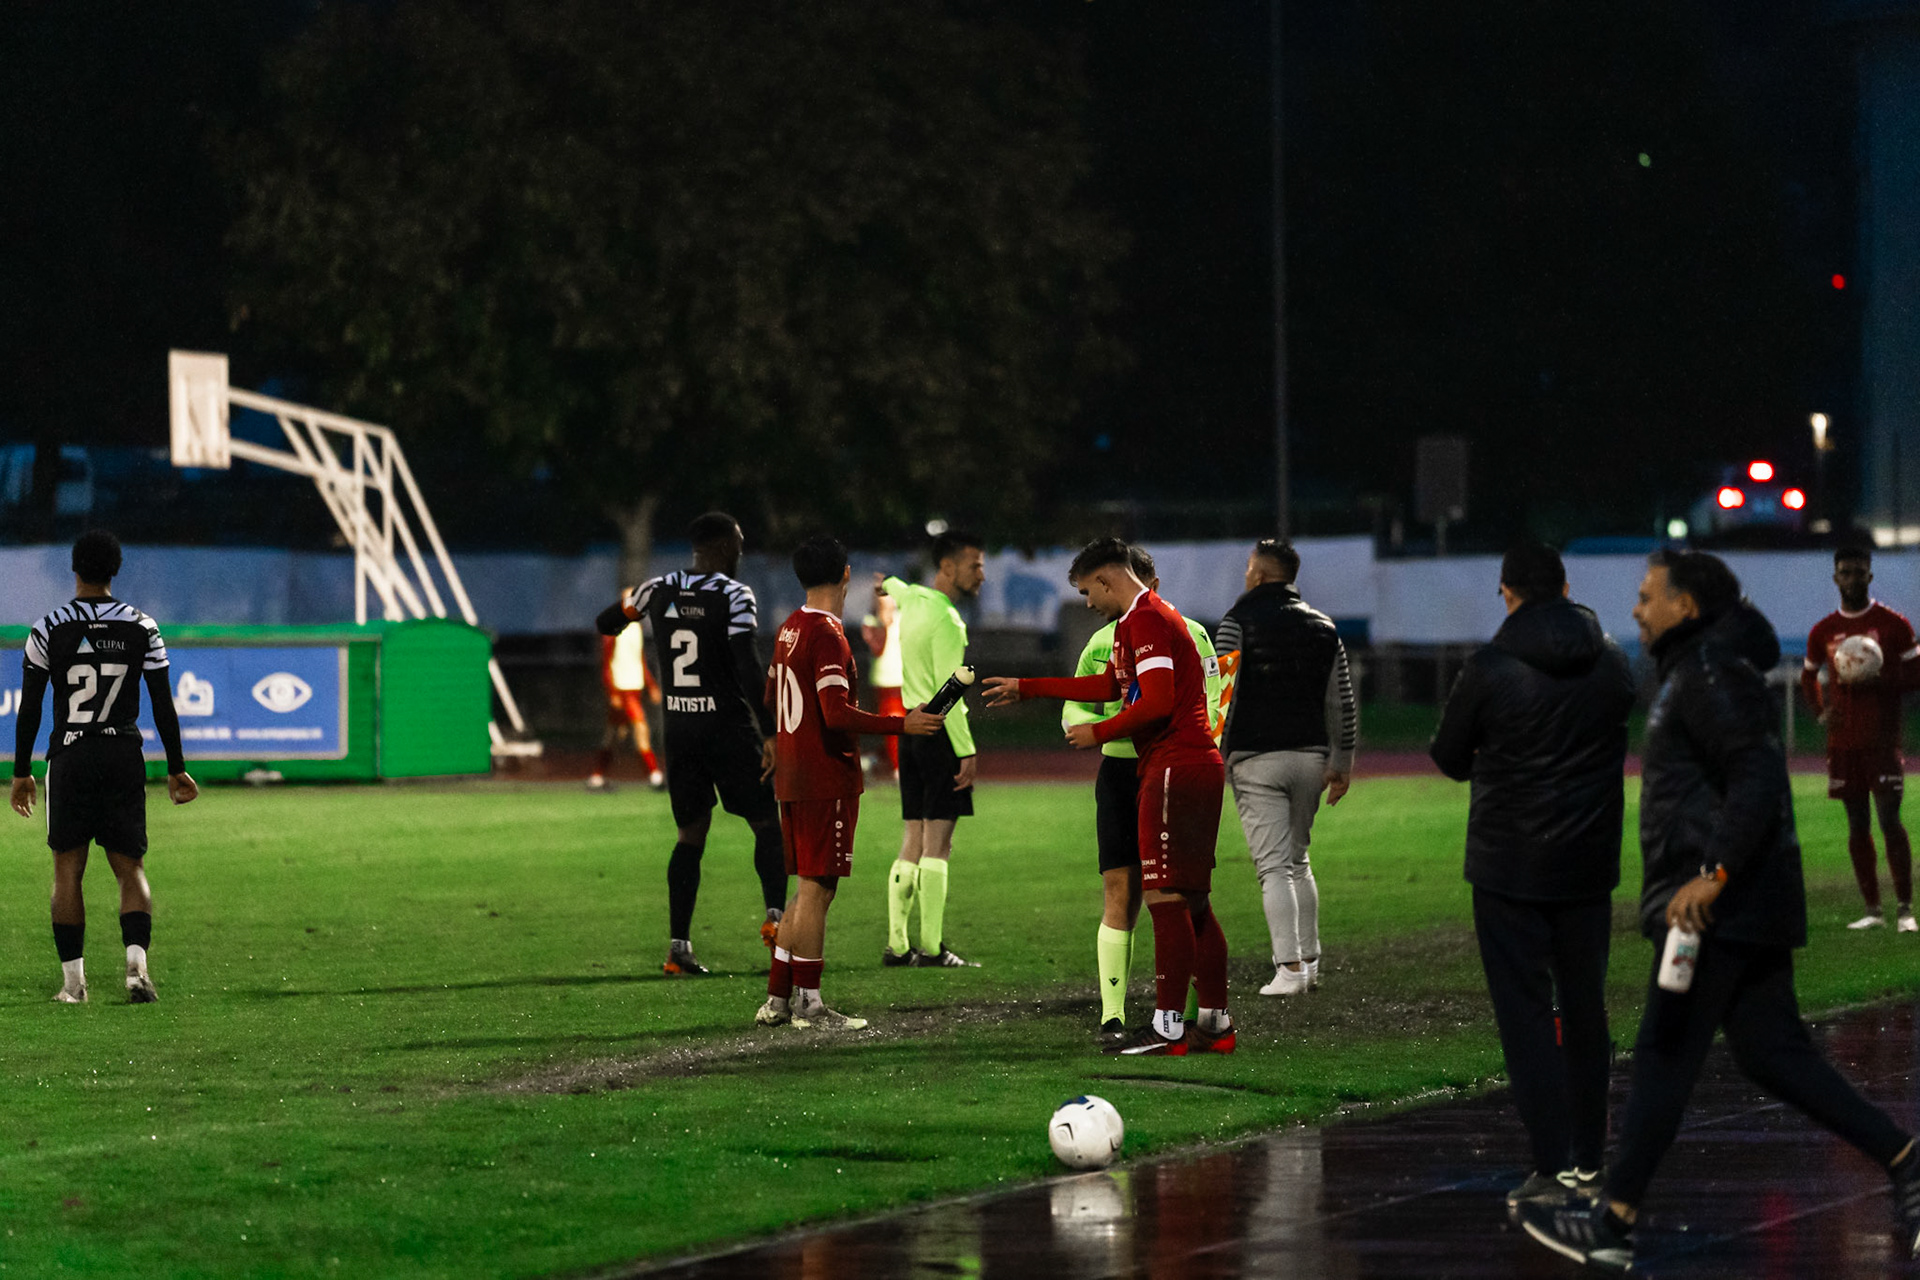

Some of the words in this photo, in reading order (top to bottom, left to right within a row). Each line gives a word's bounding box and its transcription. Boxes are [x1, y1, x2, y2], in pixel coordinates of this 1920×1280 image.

[95, 639, 127, 650] CLIPAL
[670, 629, 701, 687] 2
[66, 663, 129, 723] 27
[666, 695, 717, 713] BATISTA
[776, 663, 804, 735] 10
